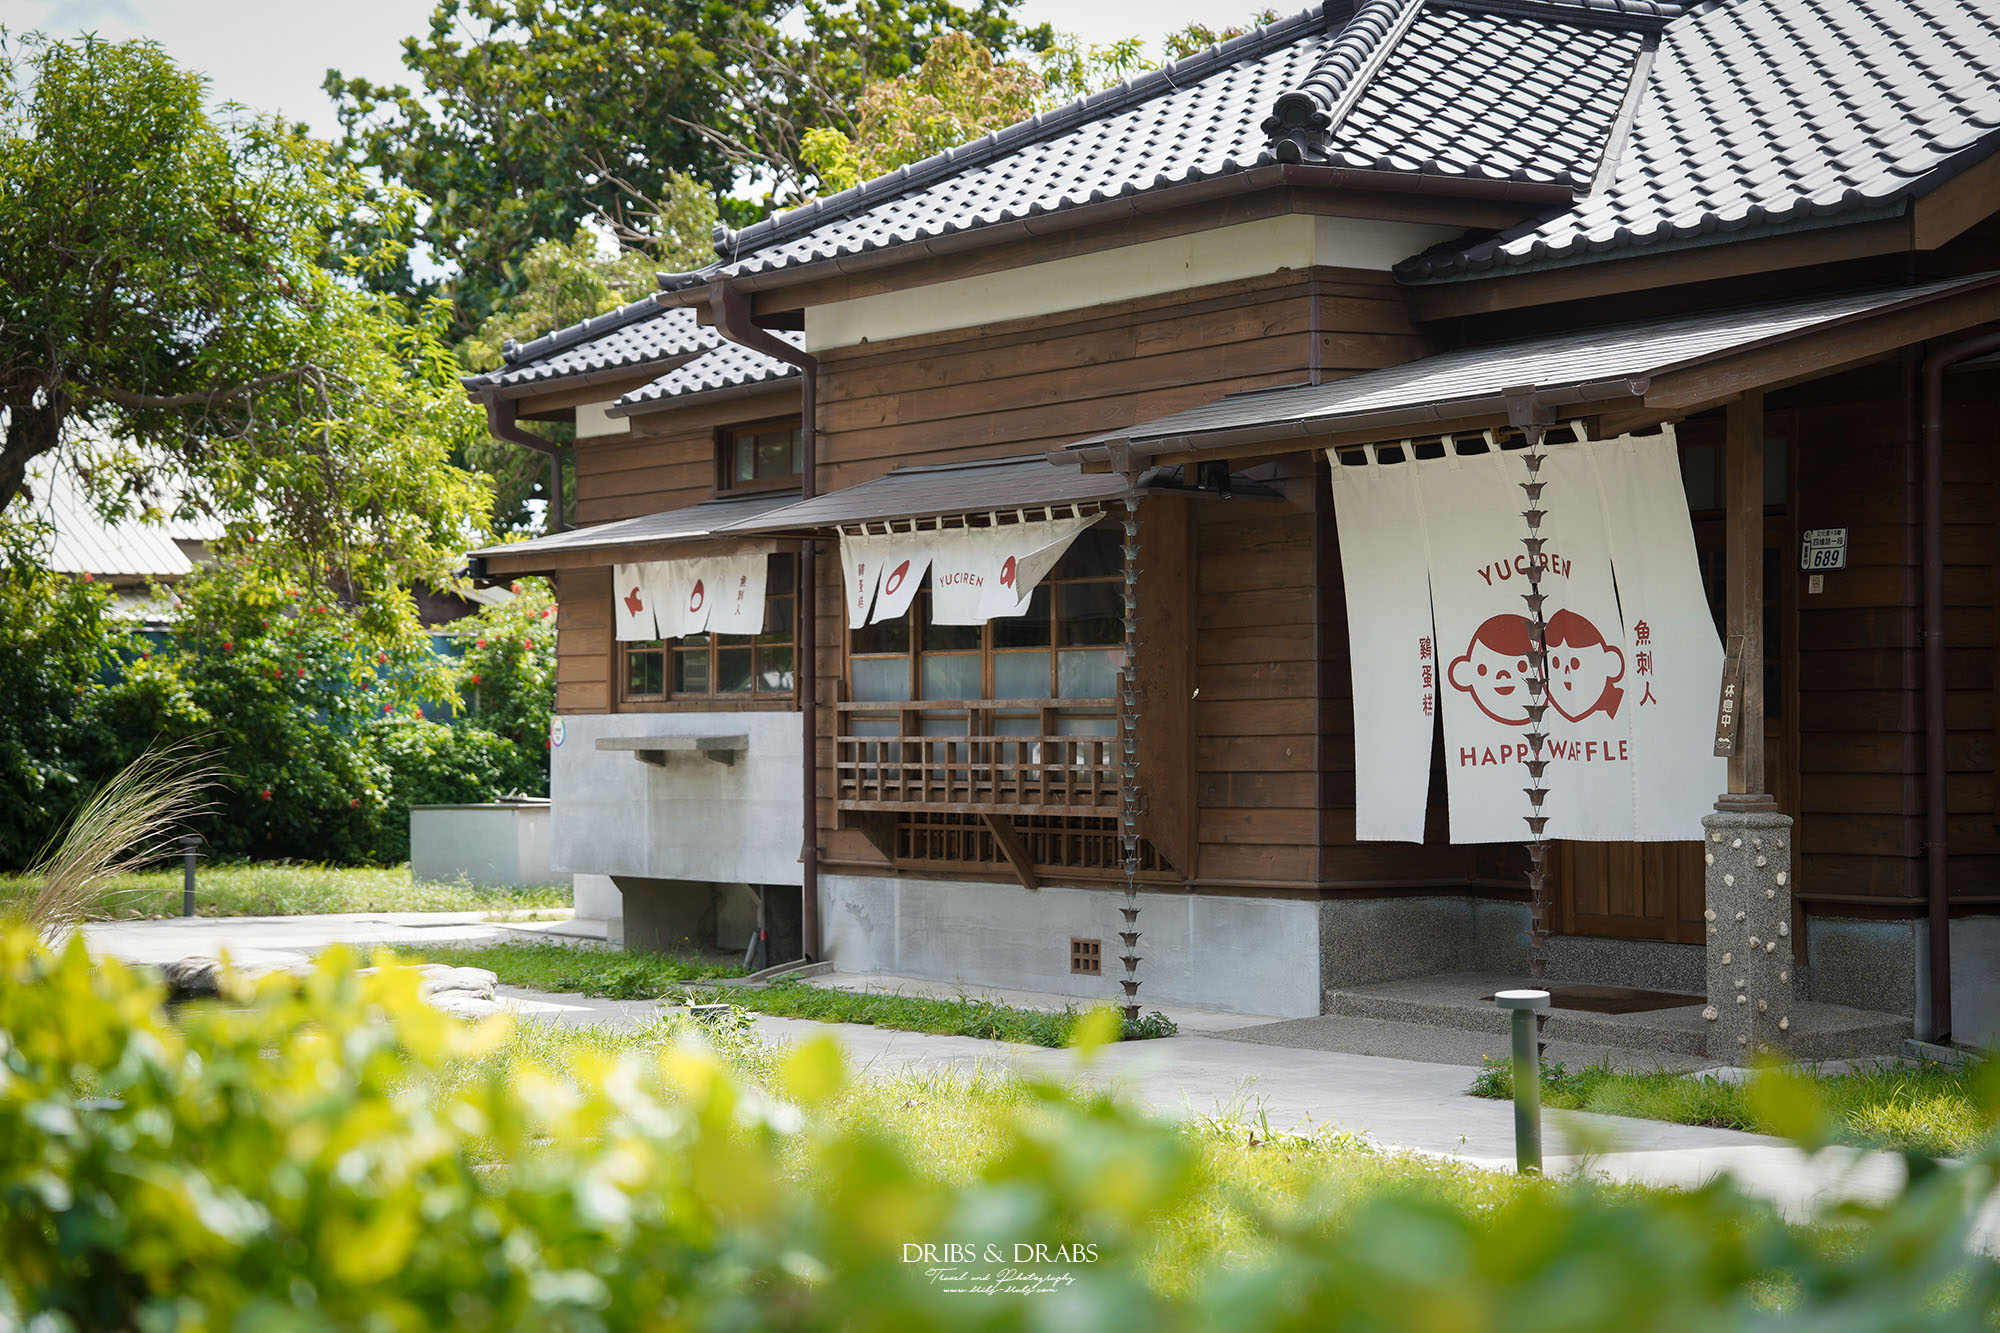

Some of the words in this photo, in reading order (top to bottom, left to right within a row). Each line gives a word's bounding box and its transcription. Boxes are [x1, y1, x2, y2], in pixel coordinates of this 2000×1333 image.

[1814, 550, 1839, 567] 689
[939, 572, 984, 588] YUCIREN
[1634, 619, 1657, 707] 魚刺人
[1721, 683, 1736, 728] 休息中
[1547, 739, 1629, 762] WAFFLE
